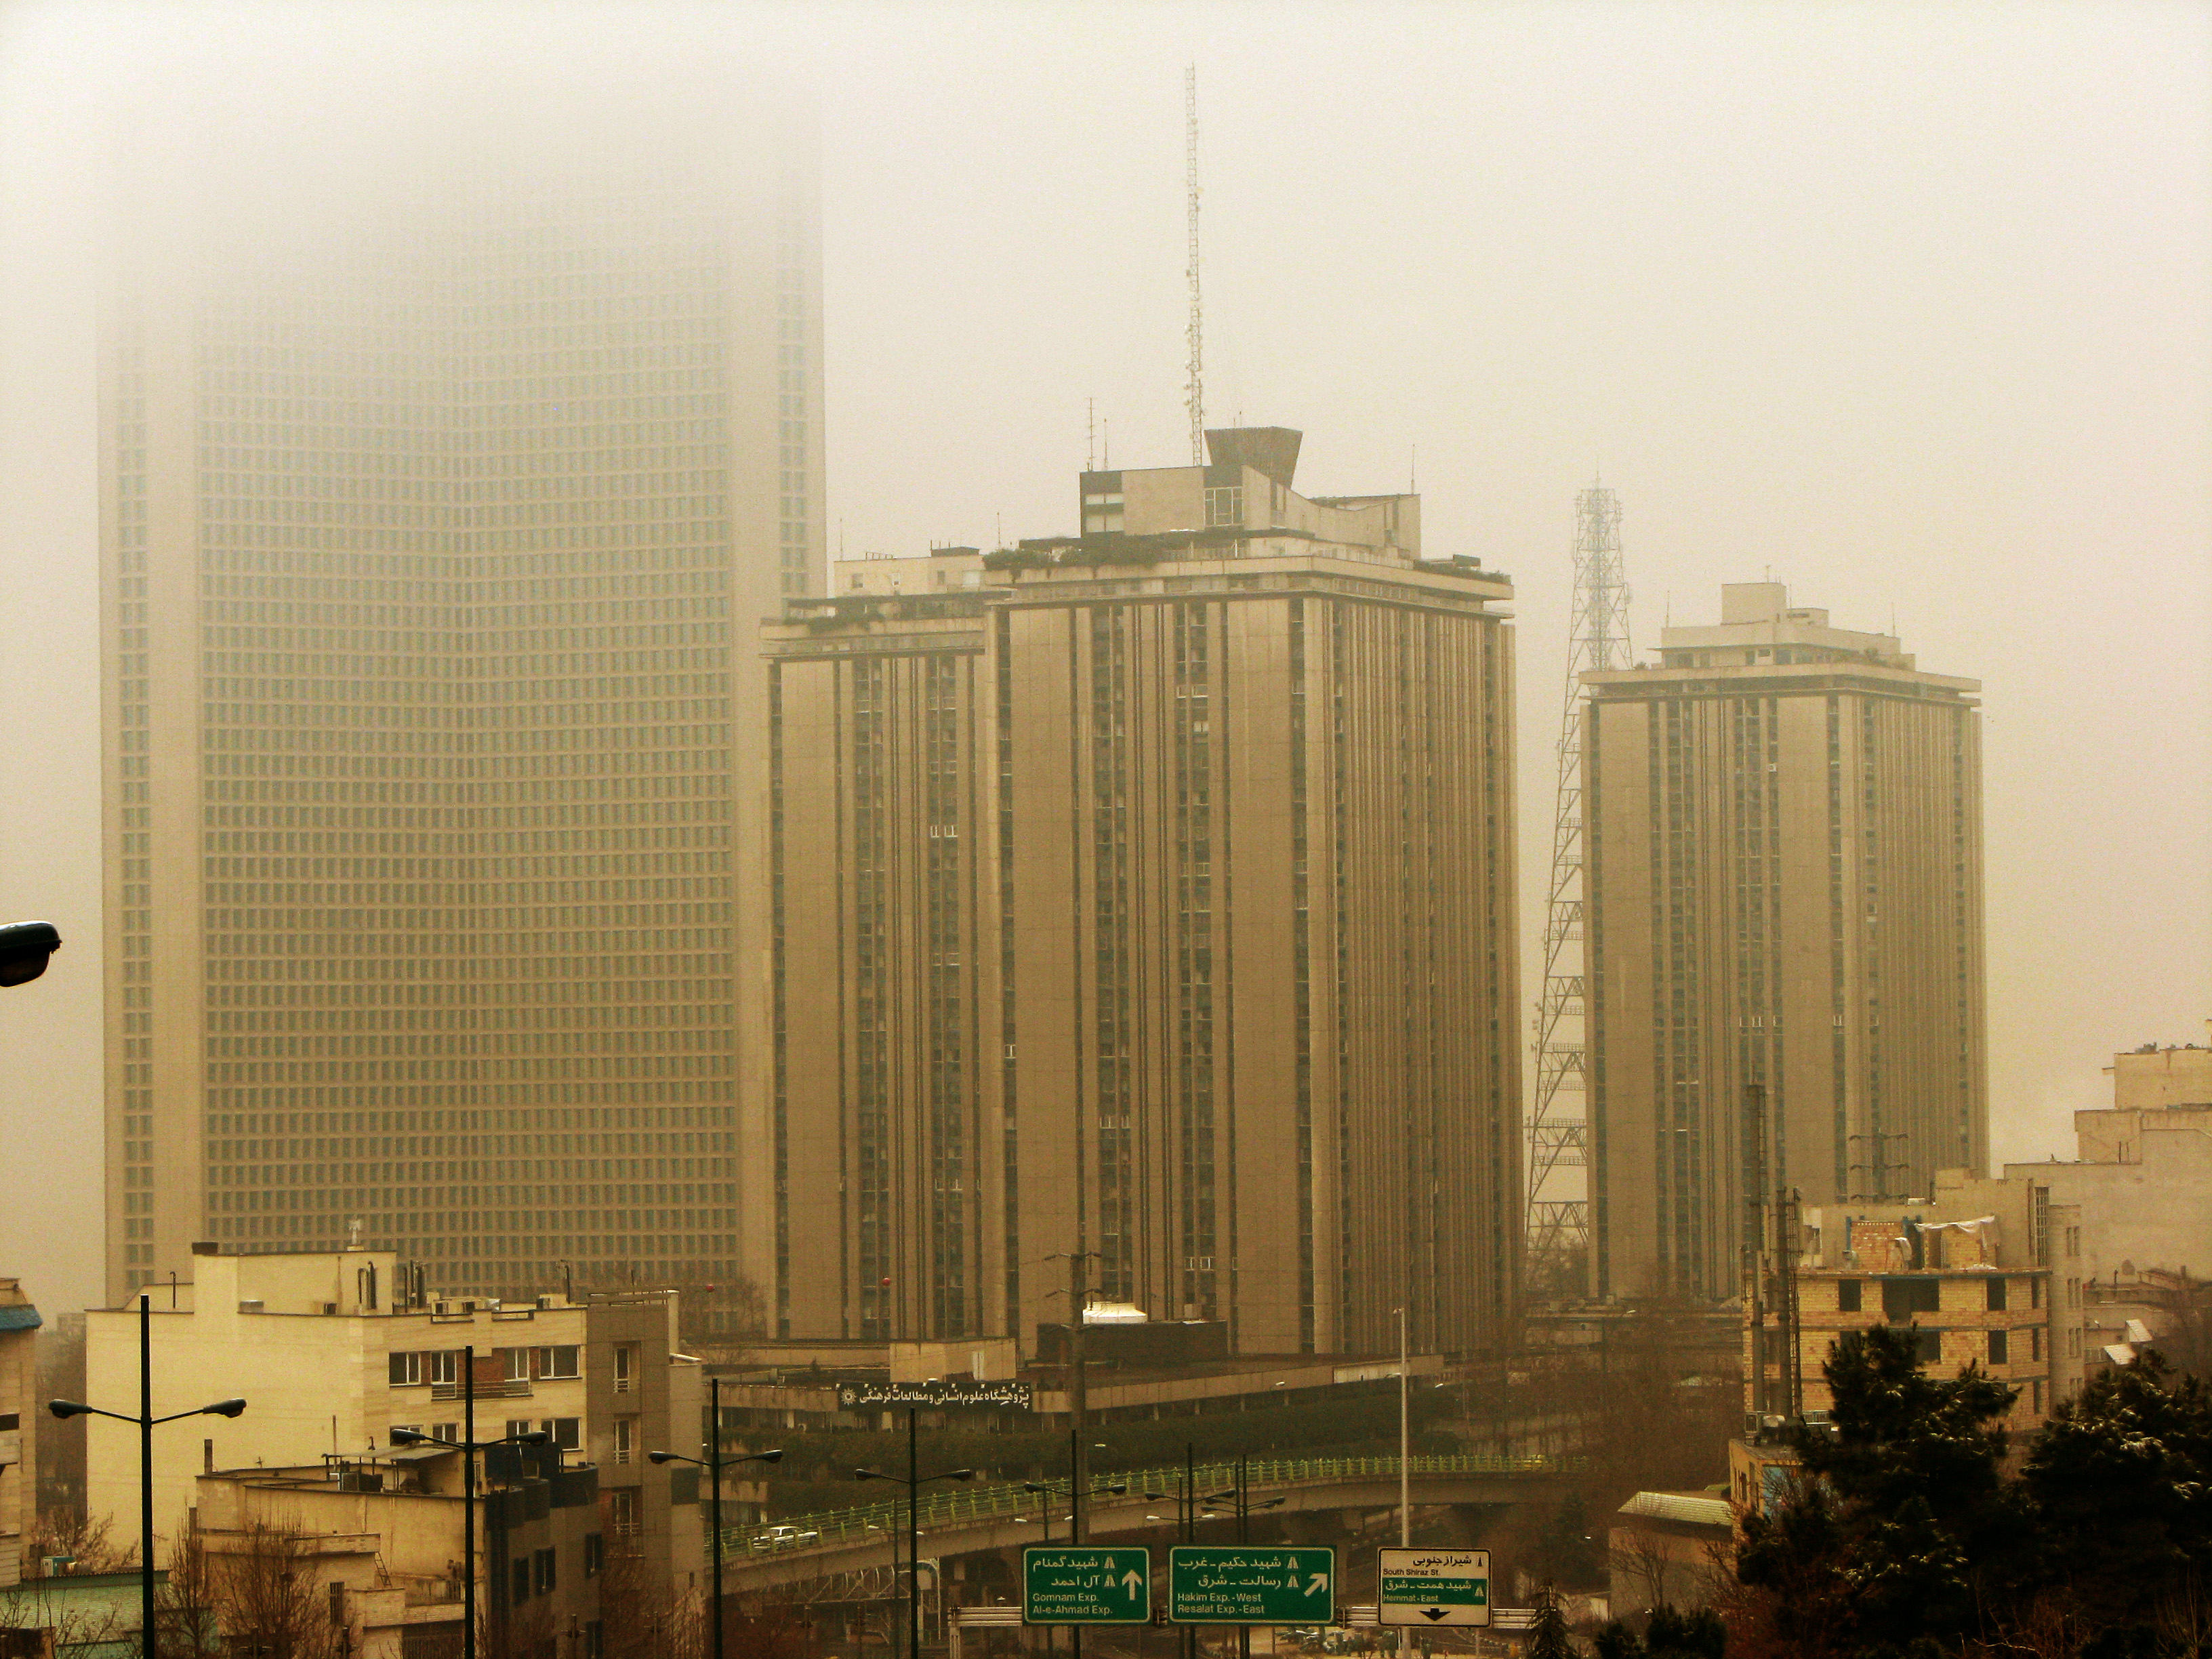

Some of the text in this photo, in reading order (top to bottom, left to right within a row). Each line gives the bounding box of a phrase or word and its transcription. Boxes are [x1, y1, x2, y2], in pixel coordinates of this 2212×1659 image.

[859, 1387, 892, 1404] فرهنگی
[892, 1389, 928, 1401] مطالعات
[928, 1393, 933, 1404] و
[934, 1389, 962, 1406] انسانی
[963, 1391, 984, 1406] علوم
[1033, 1555, 1099, 1572] شهید گمنام
[1179, 1557, 1208, 1570] غرب
[1218, 1557, 1247, 1572] حکیم
[1250, 1556, 1282, 1570] شهید
[1413, 1555, 1472, 1568] شیراز جنوبی
[1051, 1574, 1100, 1588] آل احمد
[1198, 1574, 1227, 1589] شرق
[1239, 1575, 1281, 1589] رسالت
[1385, 1580, 1408, 1591] شرق
[1446, 1580, 1472, 1591] شهید
[1033, 1593, 1099, 1603] Gomnam Exp.
[1177, 1593, 1207, 1601] Hakim
[1032, 1605, 1113, 1616] Al-e-Ahmad Exp.
[1177, 1604, 1214, 1614] Resalat
